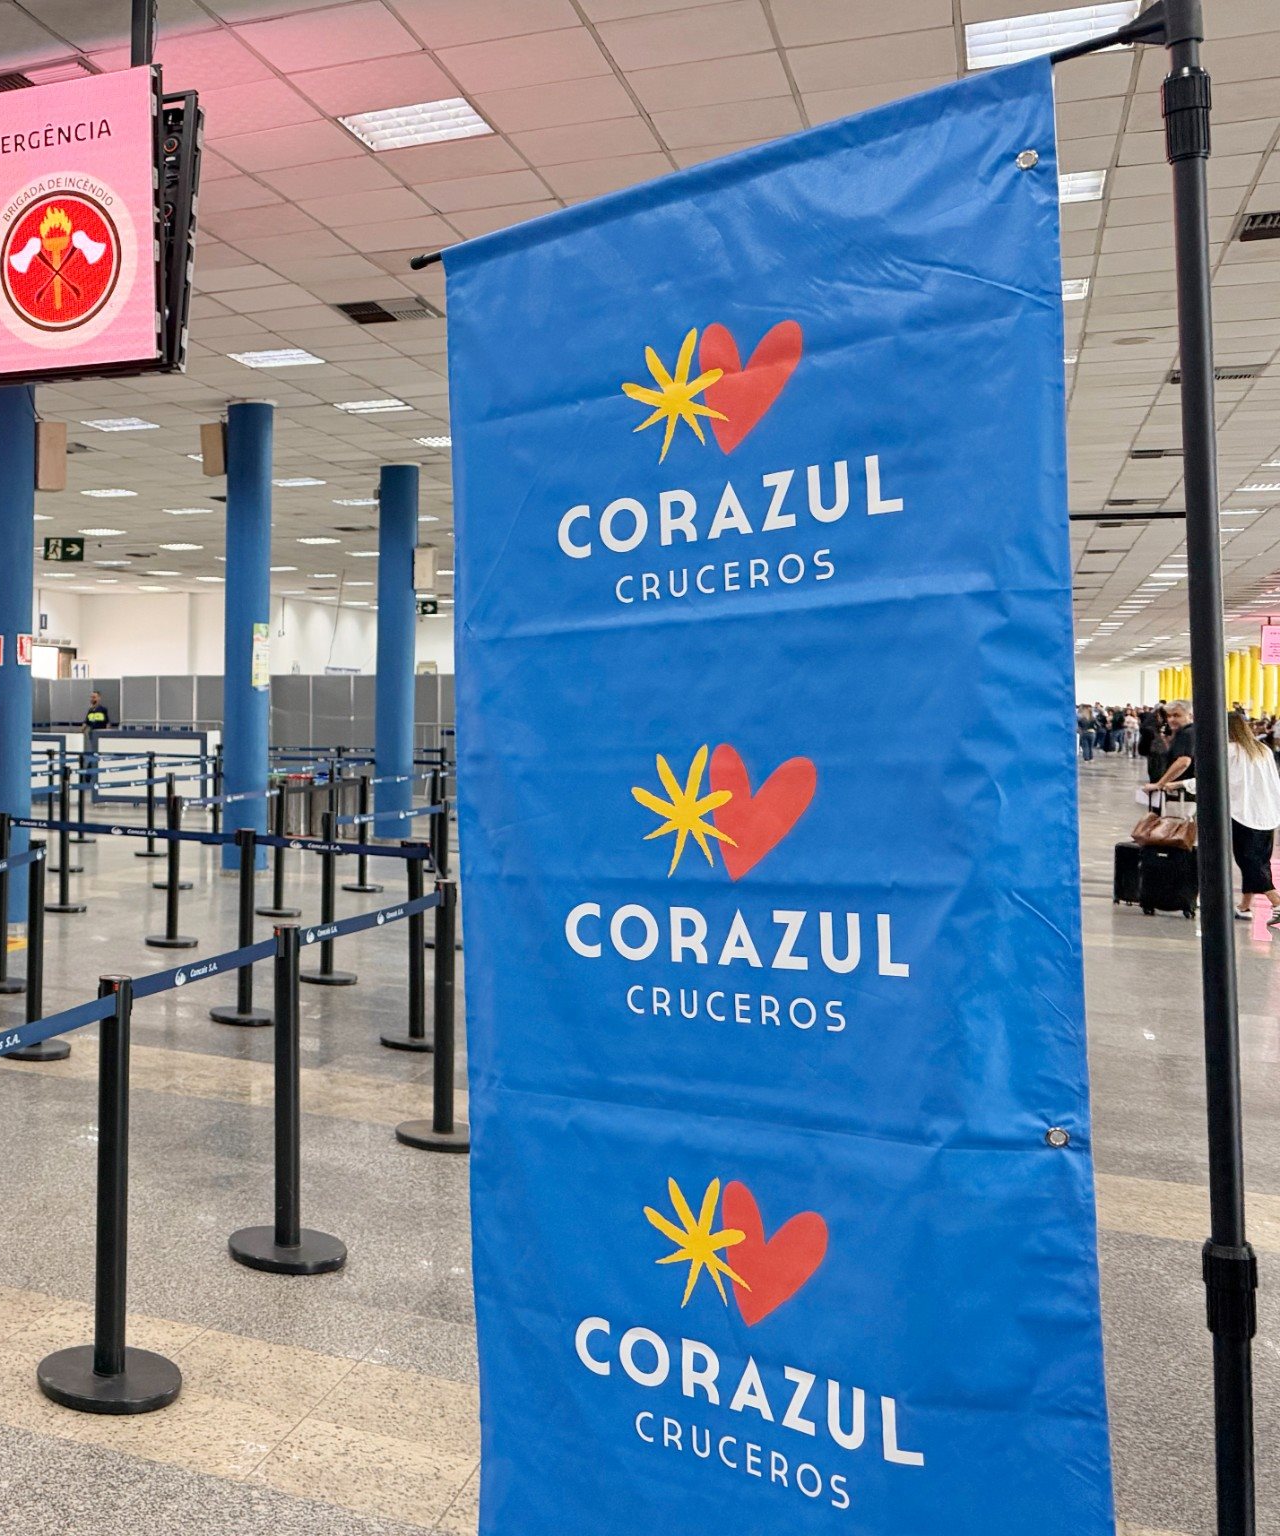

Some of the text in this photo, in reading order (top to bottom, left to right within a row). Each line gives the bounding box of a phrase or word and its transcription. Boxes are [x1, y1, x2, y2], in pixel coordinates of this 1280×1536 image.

[2, 177, 114, 222] BRIGADA DE INCÊNDIO
[557, 453, 904, 559] CORAZUL
[615, 549, 835, 603] CRUCEROS
[564, 901, 910, 978] CORAZUL
[5, 1033, 21, 1048] S.A.
[626, 985, 846, 1032] CRUCEROS
[574, 1316, 925, 1467] CORAZUL
[635, 1411, 851, 1509] CRUCEROS
